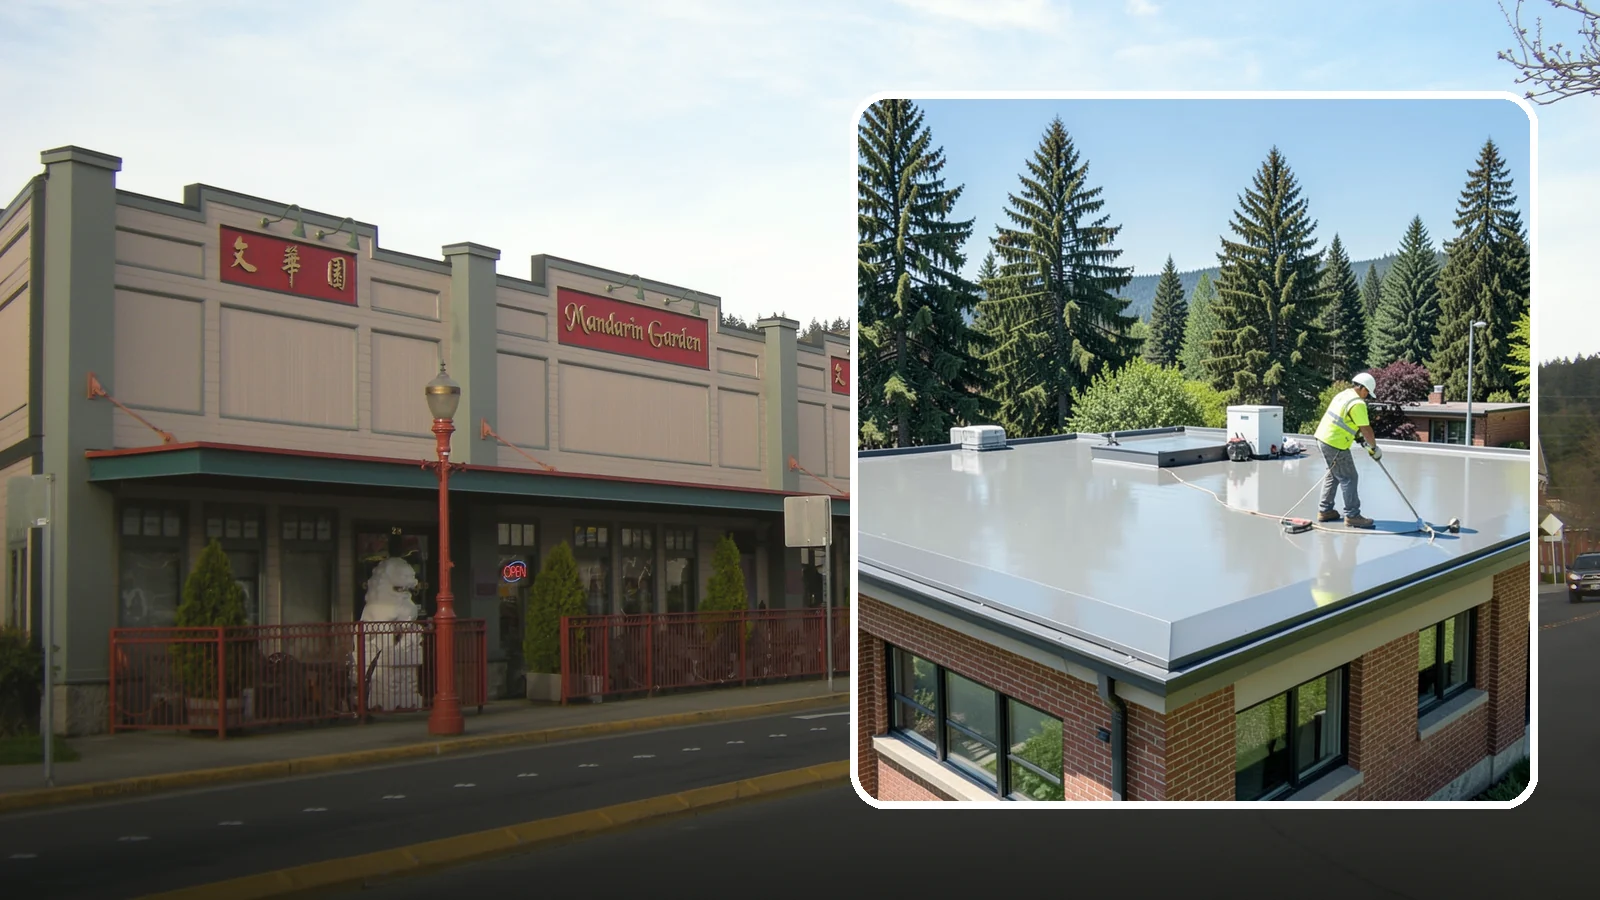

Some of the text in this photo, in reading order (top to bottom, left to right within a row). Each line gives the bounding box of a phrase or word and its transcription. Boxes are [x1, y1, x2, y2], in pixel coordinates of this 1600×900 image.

[231, 236, 346, 291] 文華園
[565, 302, 701, 352] Mandarin Garden
[835, 363, 846, 386] 文
[503, 565, 526, 577] OPEN
